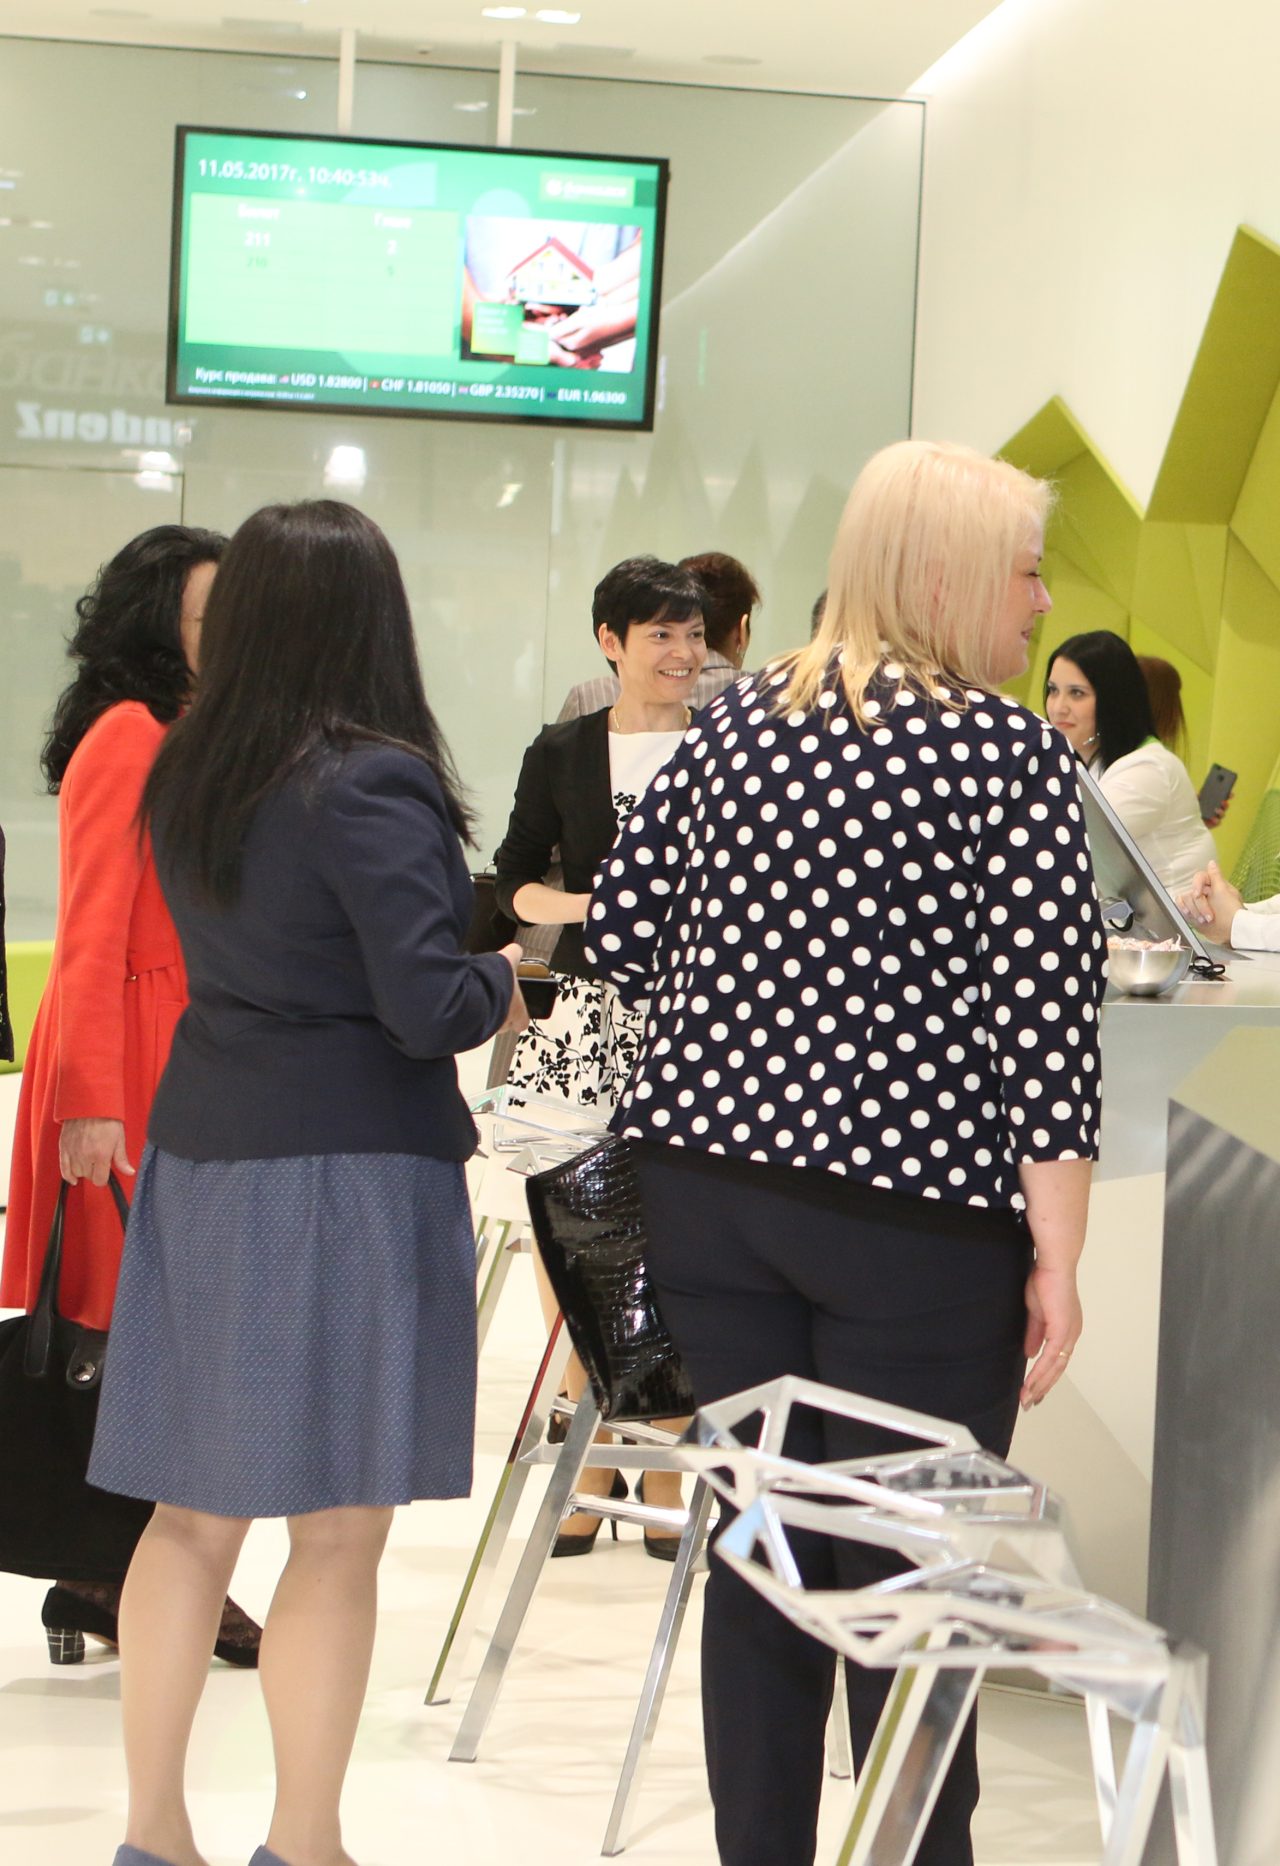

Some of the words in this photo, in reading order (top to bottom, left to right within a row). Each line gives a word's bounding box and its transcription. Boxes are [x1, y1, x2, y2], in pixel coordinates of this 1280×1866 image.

[195, 366, 223, 384] Курс
[291, 372, 316, 387] USD
[381, 378, 404, 392] CHF
[470, 383, 494, 397] GBP
[558, 388, 581, 402] EUR
